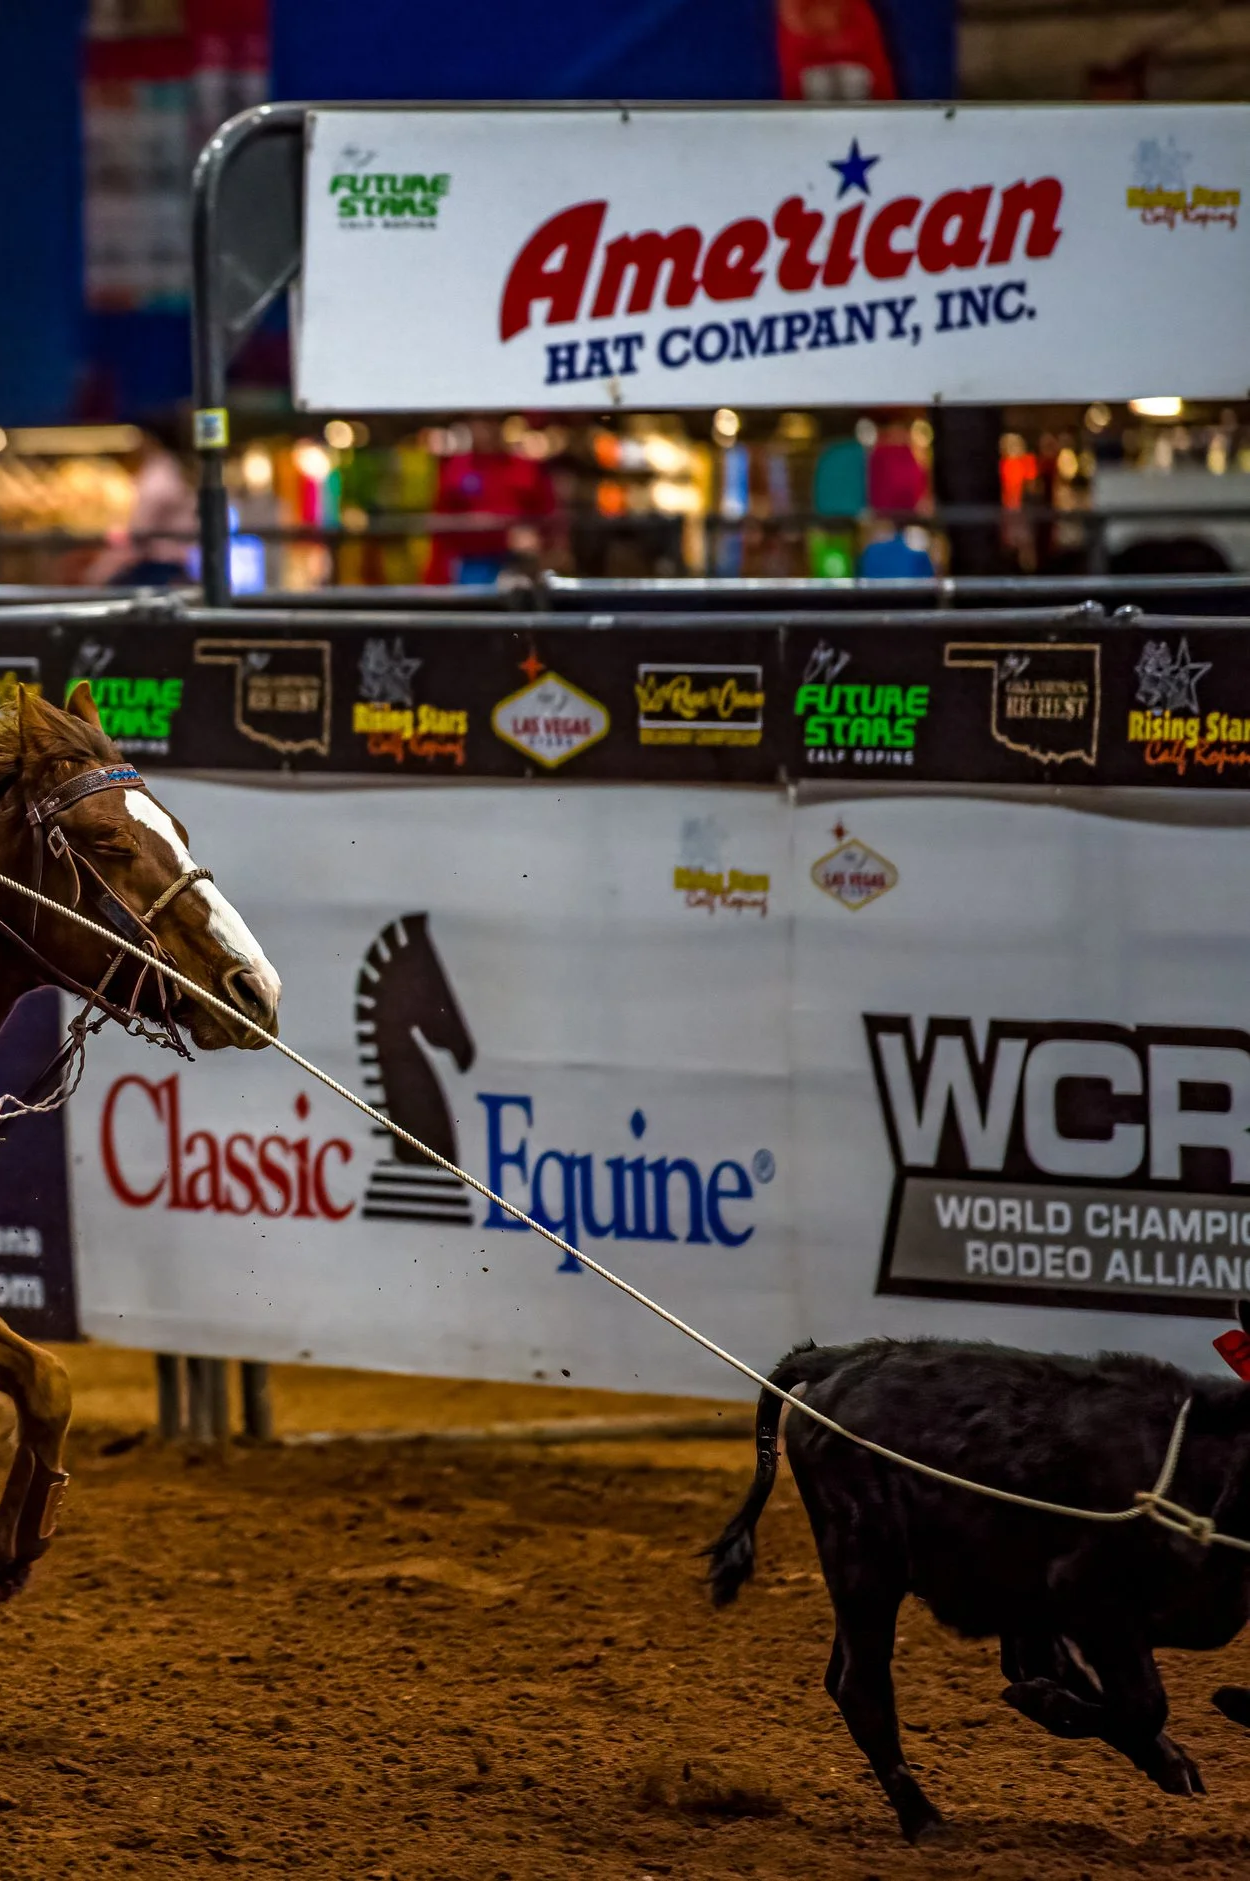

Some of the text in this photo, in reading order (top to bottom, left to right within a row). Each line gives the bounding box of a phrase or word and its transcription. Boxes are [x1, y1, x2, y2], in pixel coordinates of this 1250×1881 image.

[500, 176, 1063, 343] American
[544, 281, 1036, 384] HAT COMPANY, INC.
[794, 685, 930, 716] FUTURE
[512, 716, 591, 737] LAS VEGAS
[805, 716, 917, 747] STARS
[1128, 710, 1200, 749] Rising
[807, 749, 915, 766] CALF ROPING
[100, 1072, 356, 1222] Classic
[476, 1093, 756, 1274] Equine
[935, 1195, 1072, 1236] WORLD
[965, 1240, 1092, 1280] RODEO
